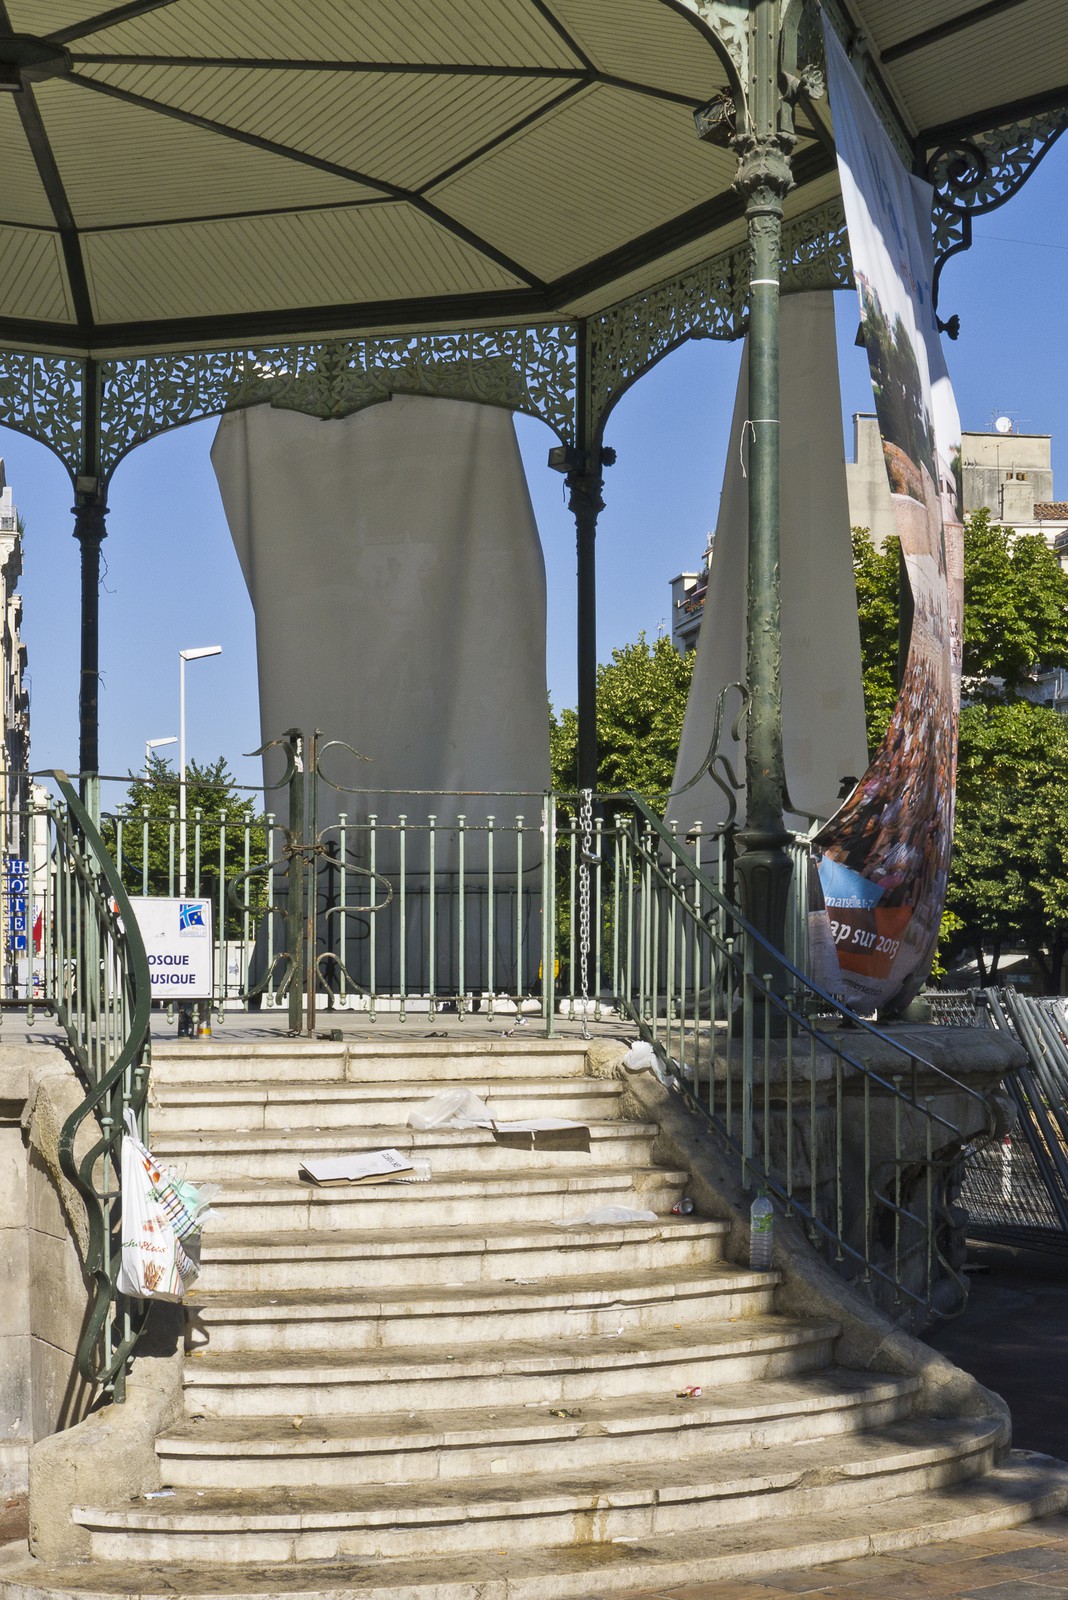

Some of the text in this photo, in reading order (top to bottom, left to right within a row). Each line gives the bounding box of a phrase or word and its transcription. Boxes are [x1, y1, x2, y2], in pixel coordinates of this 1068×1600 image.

[11, 861, 24, 950] HOTEL
[851, 929, 877, 948] sur
[876, 935, 900, 960] 2013
[147, 955, 189, 965] OSQUE
[151, 974, 196, 984] USIQUE
